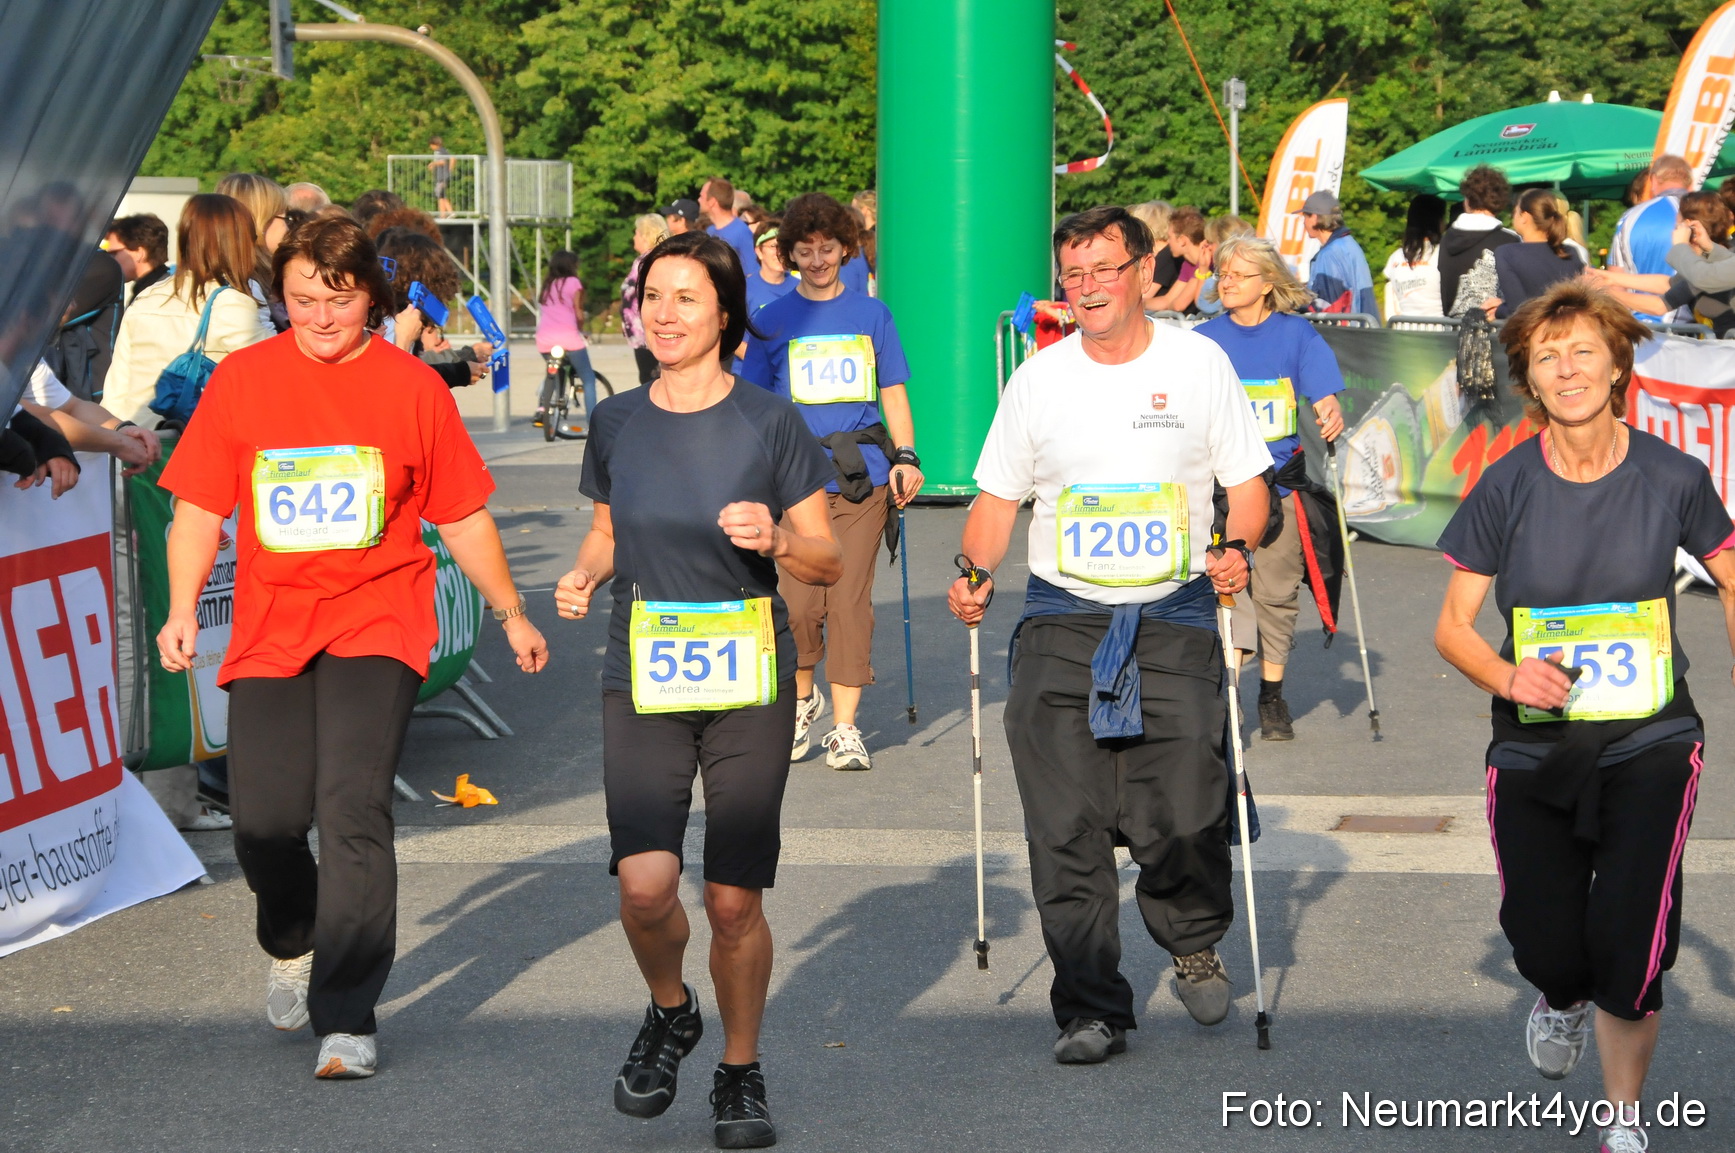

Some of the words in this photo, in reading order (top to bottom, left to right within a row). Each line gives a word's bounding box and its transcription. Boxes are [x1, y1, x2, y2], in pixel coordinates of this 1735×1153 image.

[1453, 142, 1558, 158] Lammsbräu
[801, 357, 857, 386] 140
[1132, 420, 1185, 429] Lammsbräu
[270, 468, 311, 479] firmenlauf
[269, 482, 357, 526] 642
[1074, 504, 1115, 513] firmenlauf
[279, 526, 329, 537] Hildegard
[1064, 520, 1168, 557] 1208
[1087, 561, 1116, 571] Franz
[650, 624, 696, 633] firmenlauf
[1537, 626, 1585, 638] firmenlauf
[649, 640, 737, 682] 551
[659, 685, 700, 694] Andrea
